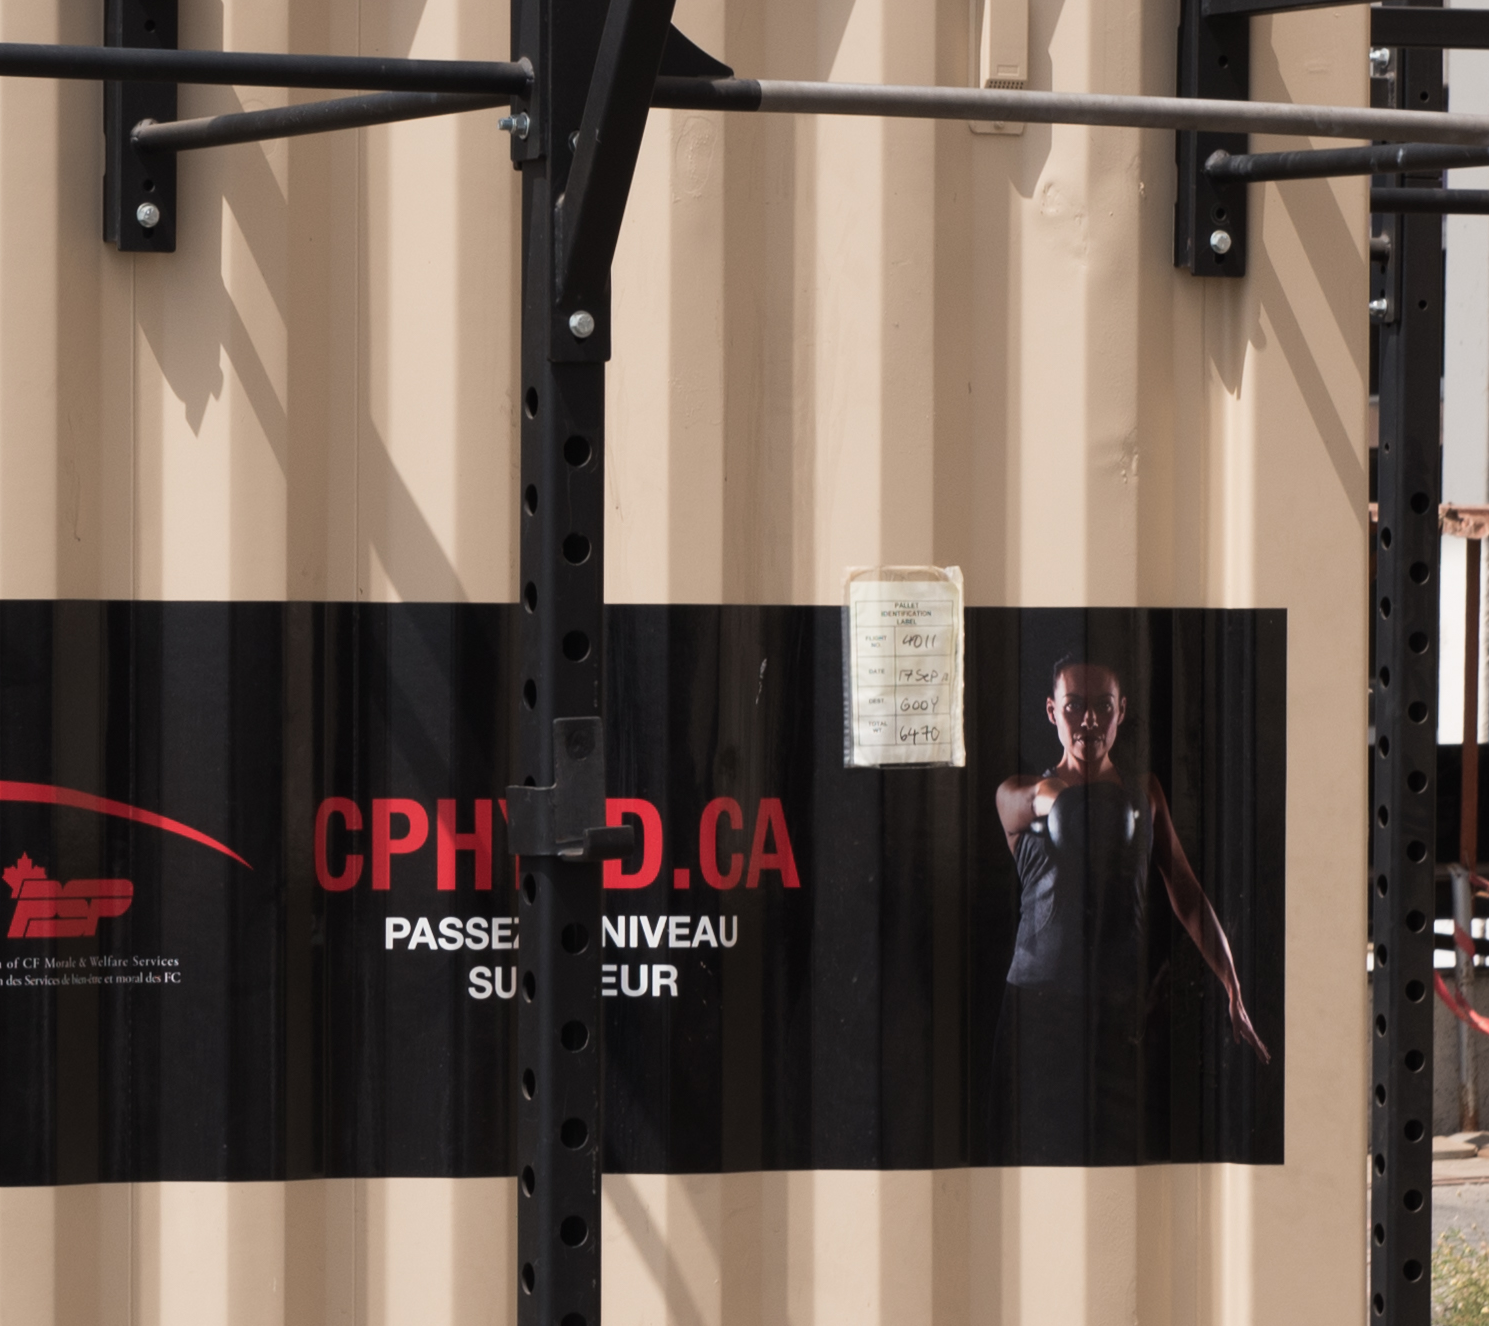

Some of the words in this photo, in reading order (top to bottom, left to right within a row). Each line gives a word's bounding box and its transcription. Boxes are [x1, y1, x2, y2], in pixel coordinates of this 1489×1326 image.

[902, 634, 937, 649] 4011
[899, 725, 940, 745] 6470
[313, 796, 802, 892] CPHD.CA
[601, 915, 739, 949] NIVEAU
[7, 957, 20, 969] of
[22, 958, 40, 969] CF
[45, 957, 76, 968] Morale
[79, 957, 87, 968] &
[89, 955, 129, 968] Welfare
[132, 955, 179, 967] Services
[6, 974, 22, 986] des
[24, 974, 60, 986] Services
[61, 974, 71, 985] de
[104, 974, 114, 985] et
[116, 972, 143, 984] moral
[145, 972, 161, 984] des
[164, 972, 181, 984] FC
[468, 964, 678, 1000] SUEUR
